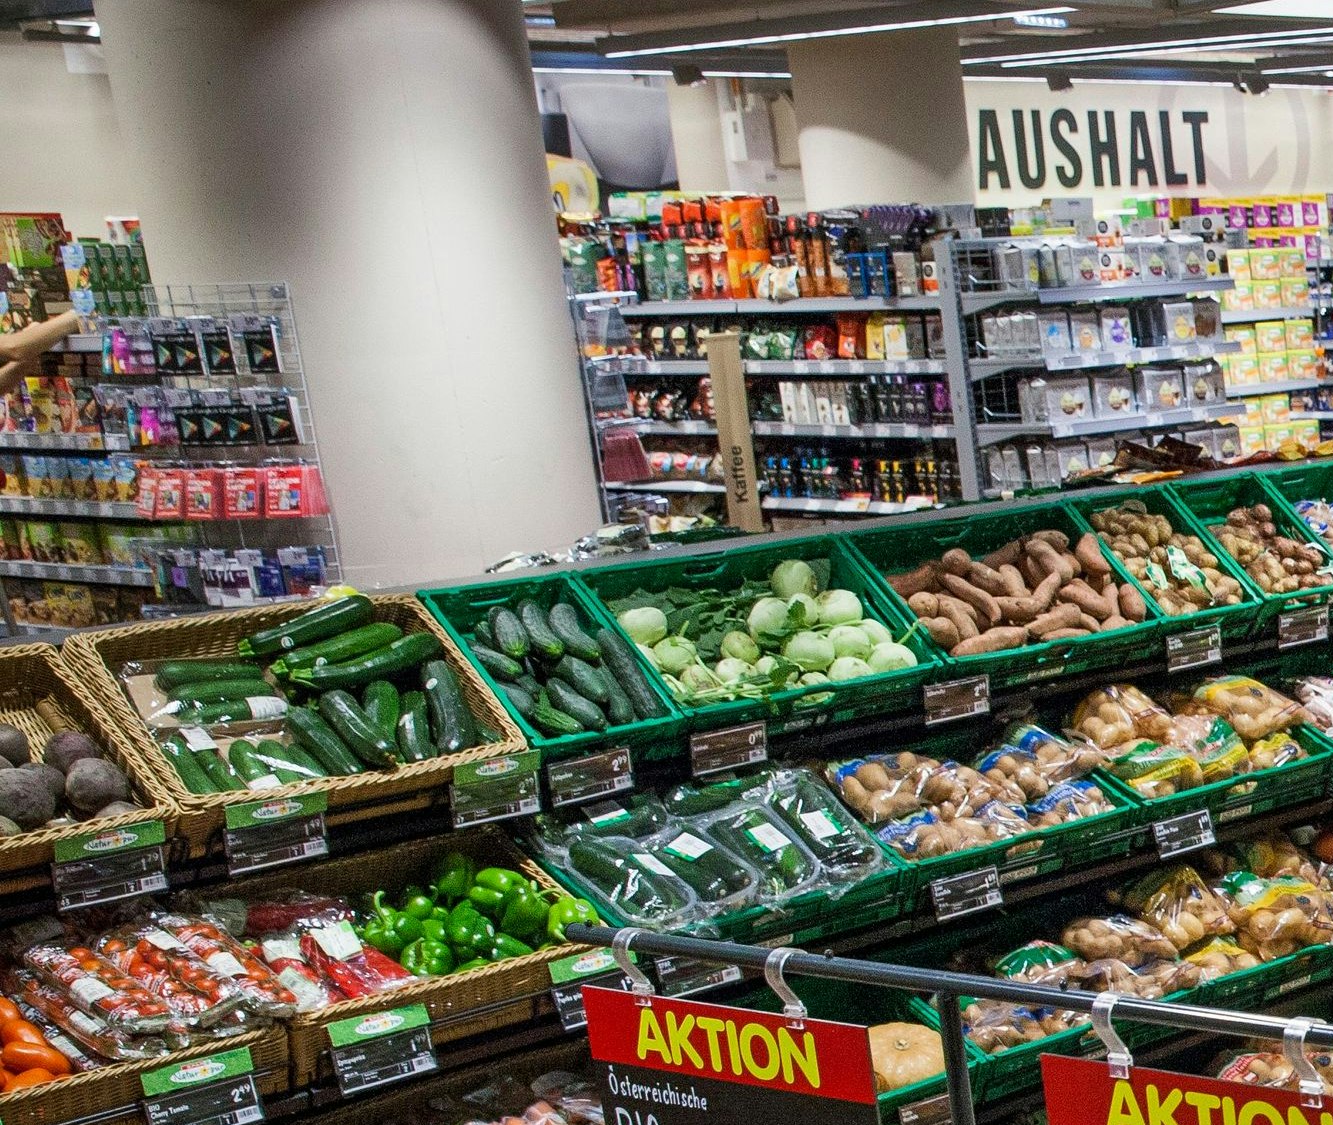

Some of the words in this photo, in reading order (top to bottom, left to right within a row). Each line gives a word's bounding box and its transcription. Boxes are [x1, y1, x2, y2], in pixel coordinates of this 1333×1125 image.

[733, 445, 751, 505] Kaffee
[636, 1007, 820, 1088] AKTION
[607, 1064, 709, 1111] Österreichische
